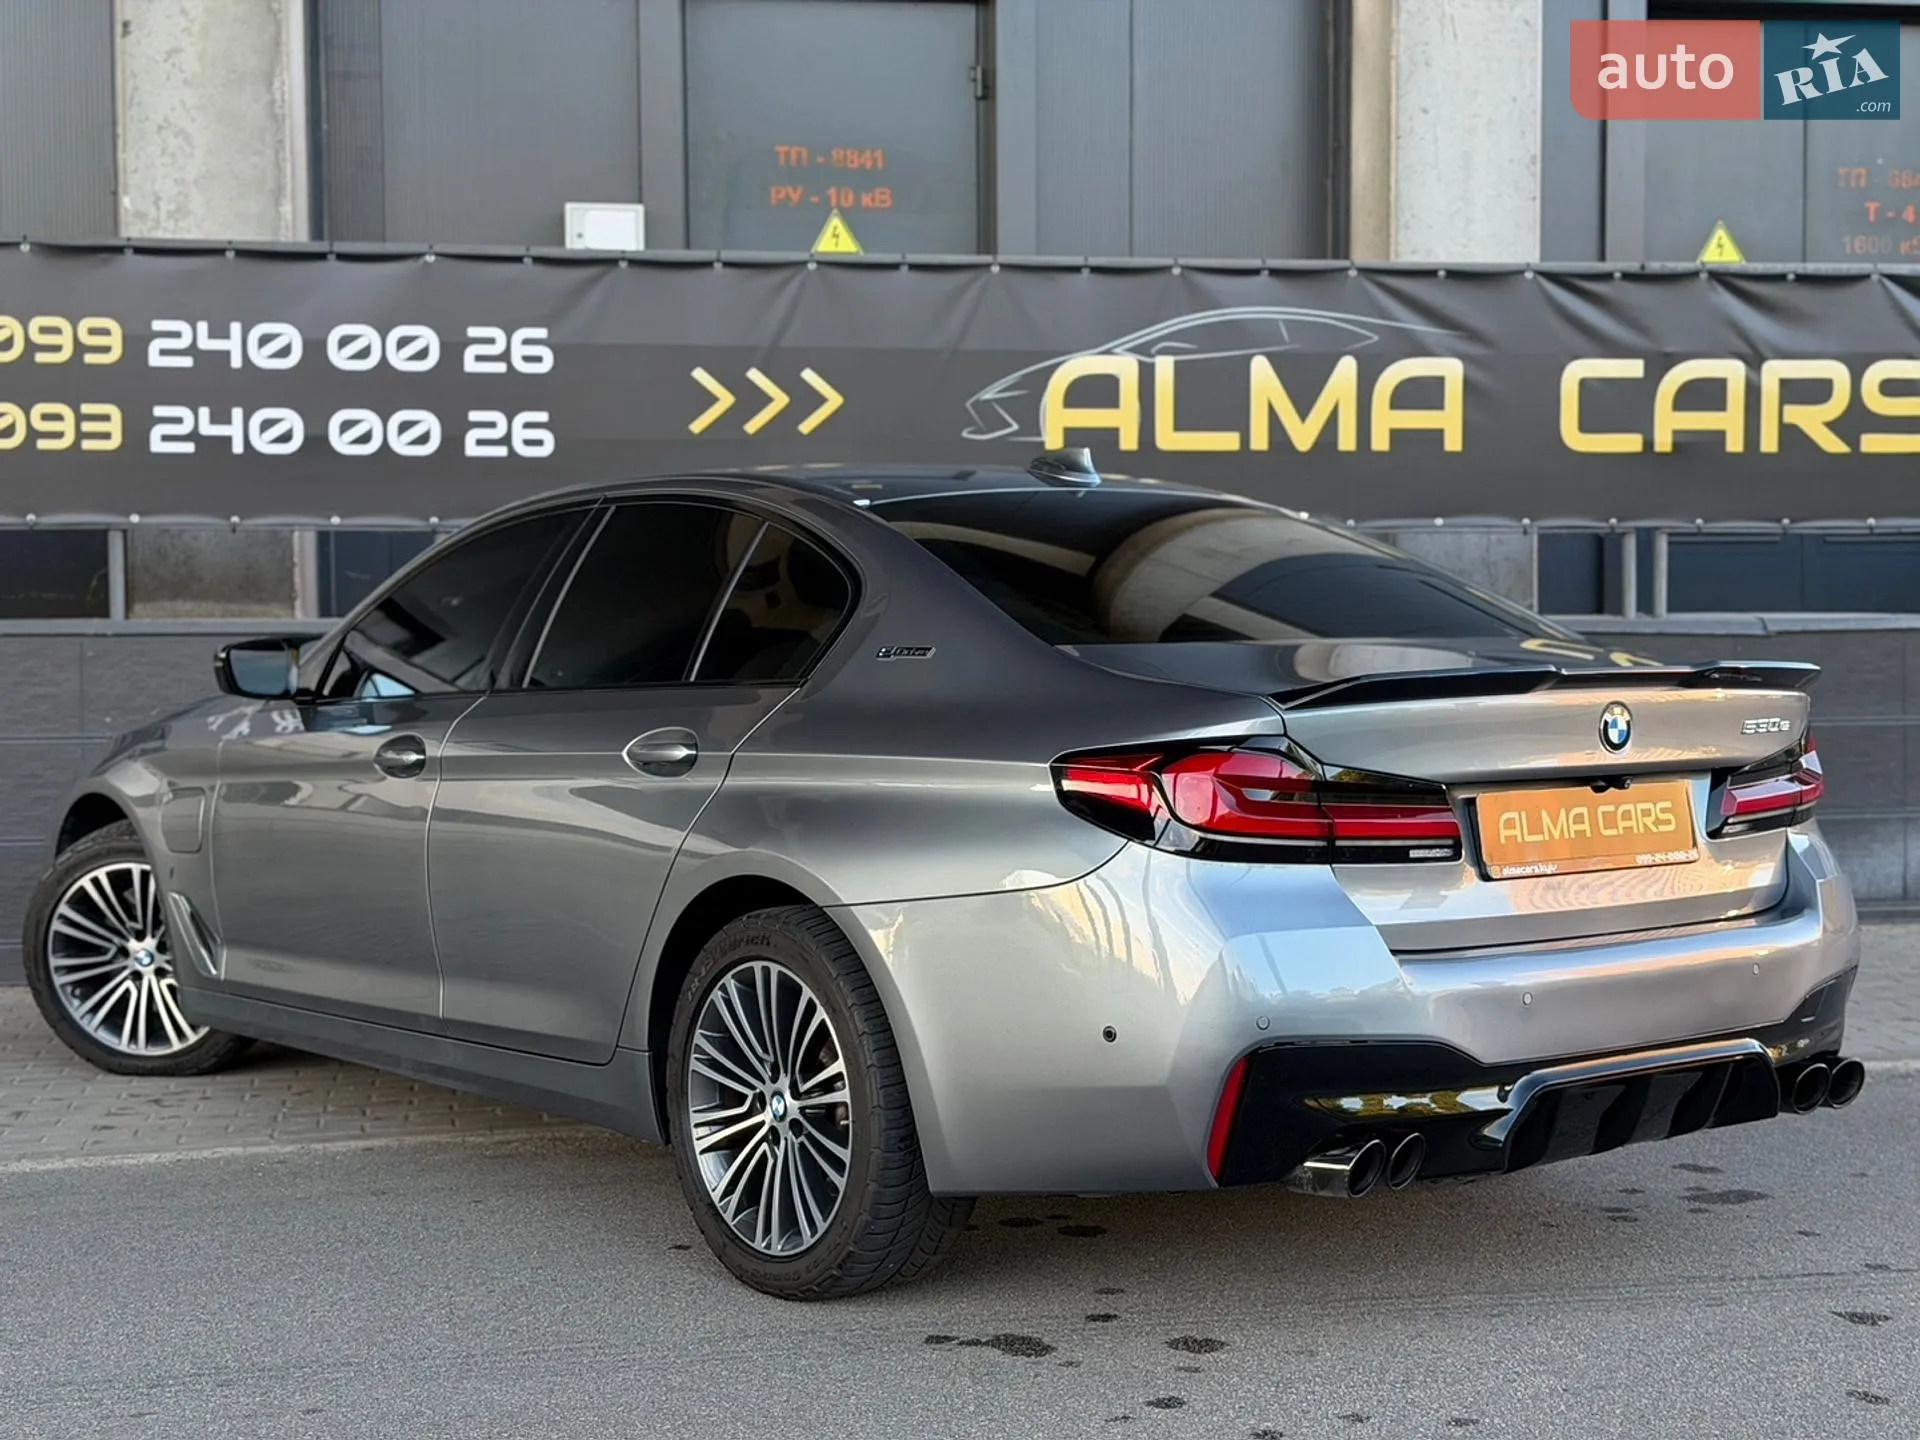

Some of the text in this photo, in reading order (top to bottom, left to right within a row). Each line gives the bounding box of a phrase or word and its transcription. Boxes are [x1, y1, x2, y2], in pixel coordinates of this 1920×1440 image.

[827, 186, 855, 208] 10
[1902, 204, 1917, 223] 4
[148, 319, 303, 370] 240
[326, 323, 441, 371] 00
[463, 326, 554, 374] 26
[1043, 355, 1920, 454] ALMA CARS
[149, 405, 304, 455] 240
[328, 408, 442, 457] 00
[464, 410, 556, 458] 26
[1498, 801, 1676, 844] ALMA CARS
